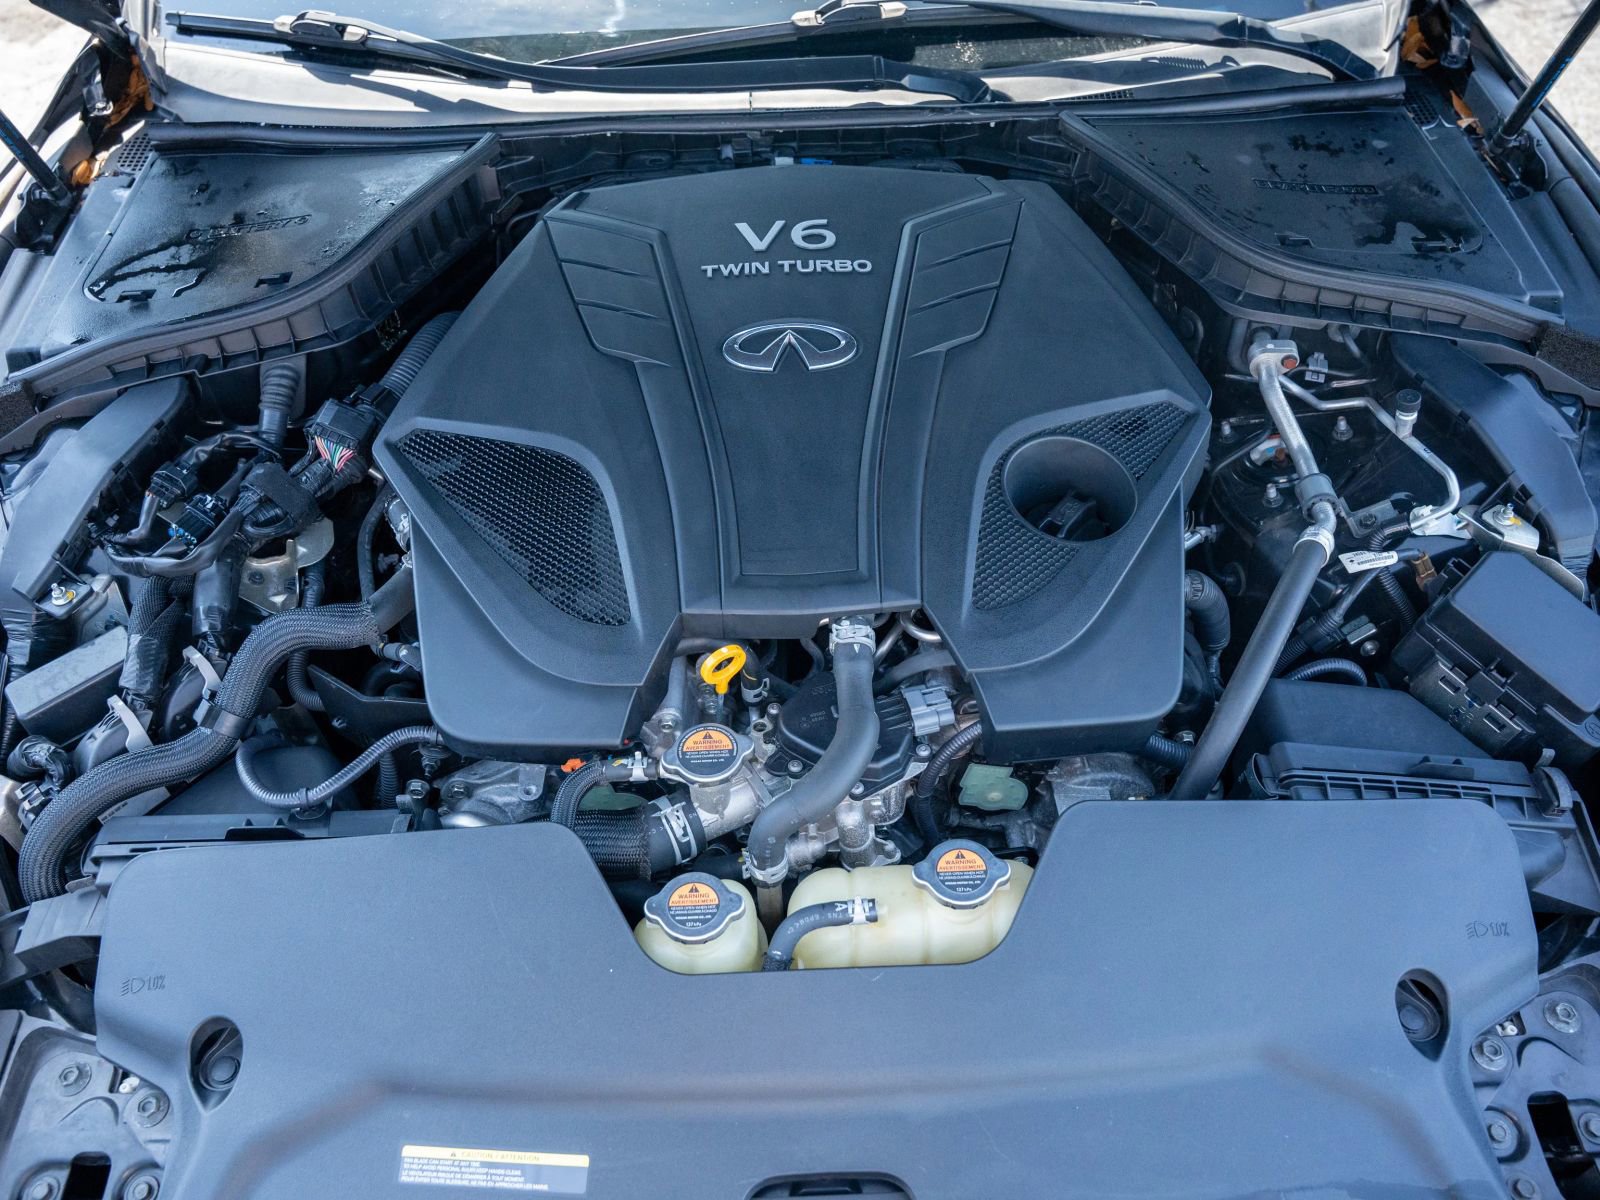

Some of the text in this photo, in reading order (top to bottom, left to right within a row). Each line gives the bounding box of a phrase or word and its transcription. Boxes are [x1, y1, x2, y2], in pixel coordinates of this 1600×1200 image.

[734, 219, 836, 251] V6
[701, 259, 872, 278] TWIN TURBO
[501, 1153, 540, 1161] ATTENTION
